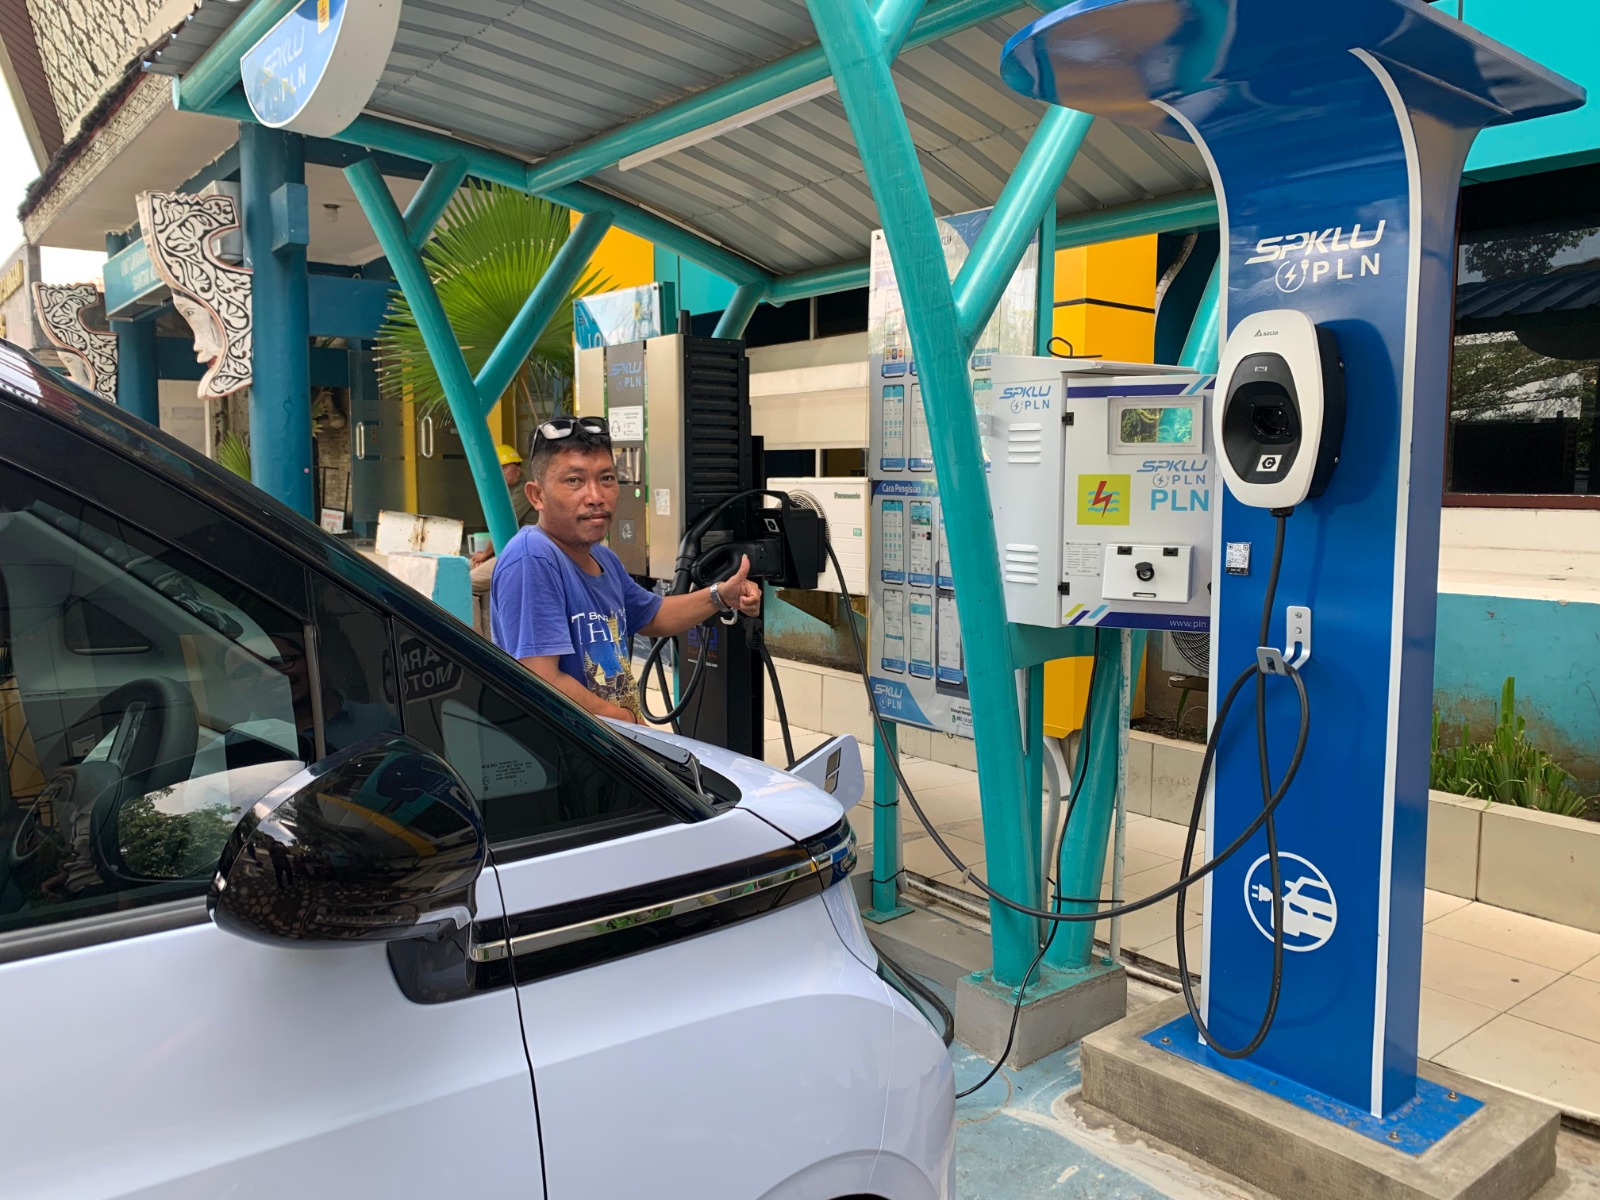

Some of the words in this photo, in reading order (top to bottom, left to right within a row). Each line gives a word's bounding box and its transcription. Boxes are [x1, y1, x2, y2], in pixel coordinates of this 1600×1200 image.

[1244, 219, 1386, 265] SPKLU
[1312, 252, 1380, 283] PLN
[608, 361, 642, 376] SPKLU
[624, 376, 641, 388] PLN
[999, 384, 1052, 400] SPKLU
[1024, 399, 1050, 410] PLN
[1136, 459, 1208, 473] SPKLU
[1171, 474, 1206, 485] PLN
[882, 484, 895, 493] Cara
[1150, 489, 1210, 512] PLN
[873, 683, 903, 699] SPKLU
[887, 698, 902, 710] PLN
